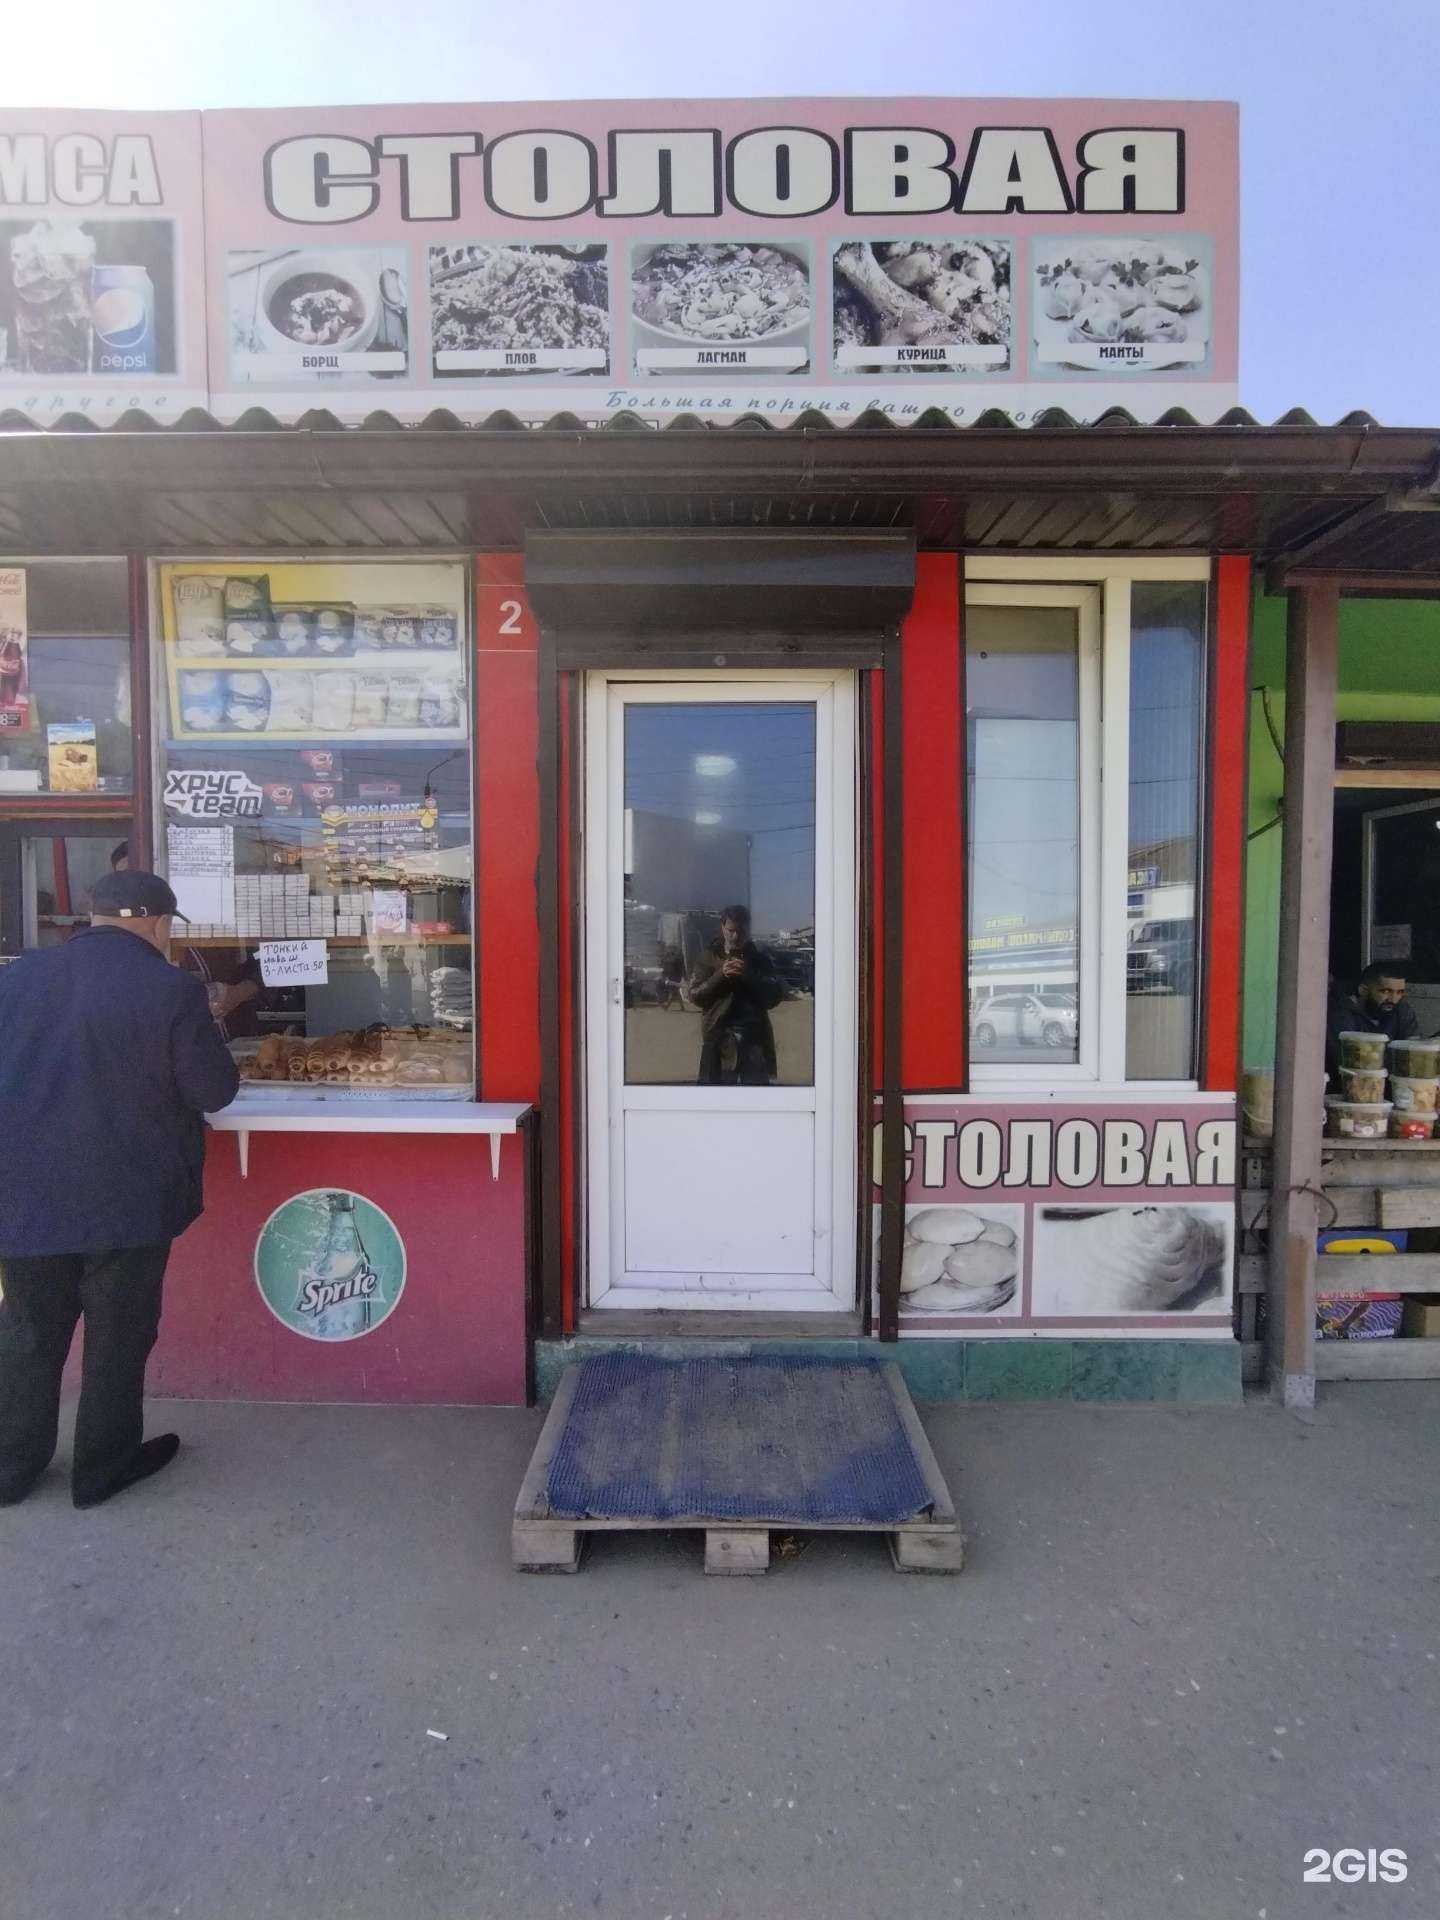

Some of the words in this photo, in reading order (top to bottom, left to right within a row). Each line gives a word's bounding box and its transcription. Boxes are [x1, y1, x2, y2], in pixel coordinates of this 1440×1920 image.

[263, 126, 1186, 225] СТОЛОВАЯ
[505, 353, 537, 365] ПЛОВ
[697, 352, 746, 364] ЛАГМАН
[897, 348, 946, 361] КУРИЦА
[1099, 347, 1144, 358] МАНТЫ
[100, 352, 146, 371] pepsi
[302, 356, 339, 368] БОРЩ
[605, 391, 733, 408] Большая
[865, 399, 965, 418] вашго
[499, 600, 522, 634] 2
[190, 793, 262, 817] team
[345, 802, 420, 816] МОНОЛИТ
[297, 1262, 378, 1317] Sprite
